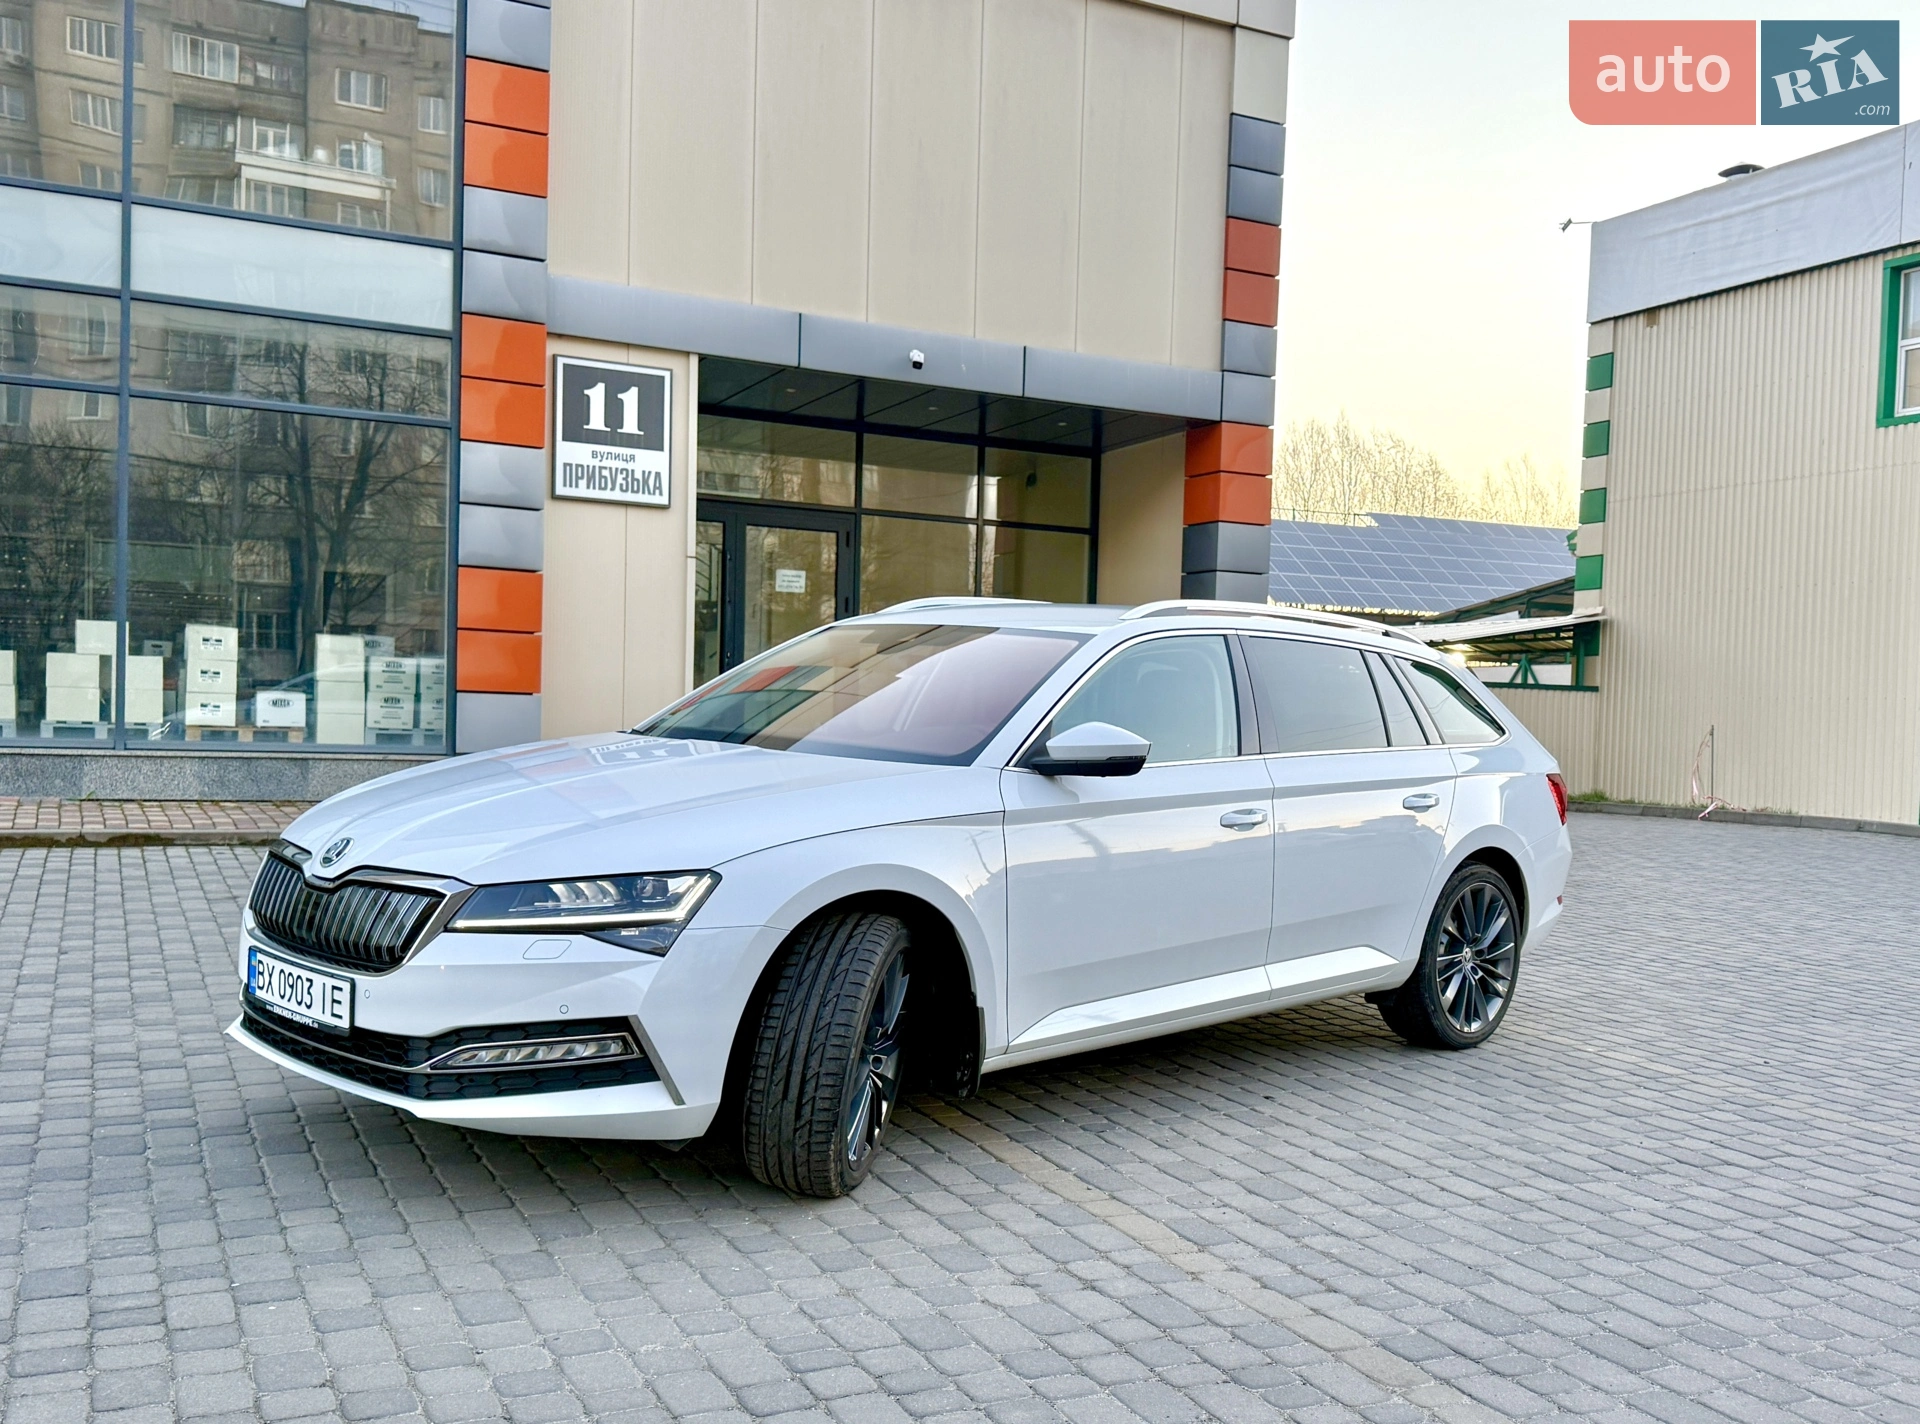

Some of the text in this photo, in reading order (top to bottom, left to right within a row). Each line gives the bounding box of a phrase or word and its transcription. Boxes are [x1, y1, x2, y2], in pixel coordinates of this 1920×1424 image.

[583, 381, 645, 435] 11
[591, 450, 636, 464] вулиця
[562, 462, 664, 497] ПРИБУЗЬКА
[257, 959, 343, 1020] BX 0903 IE
